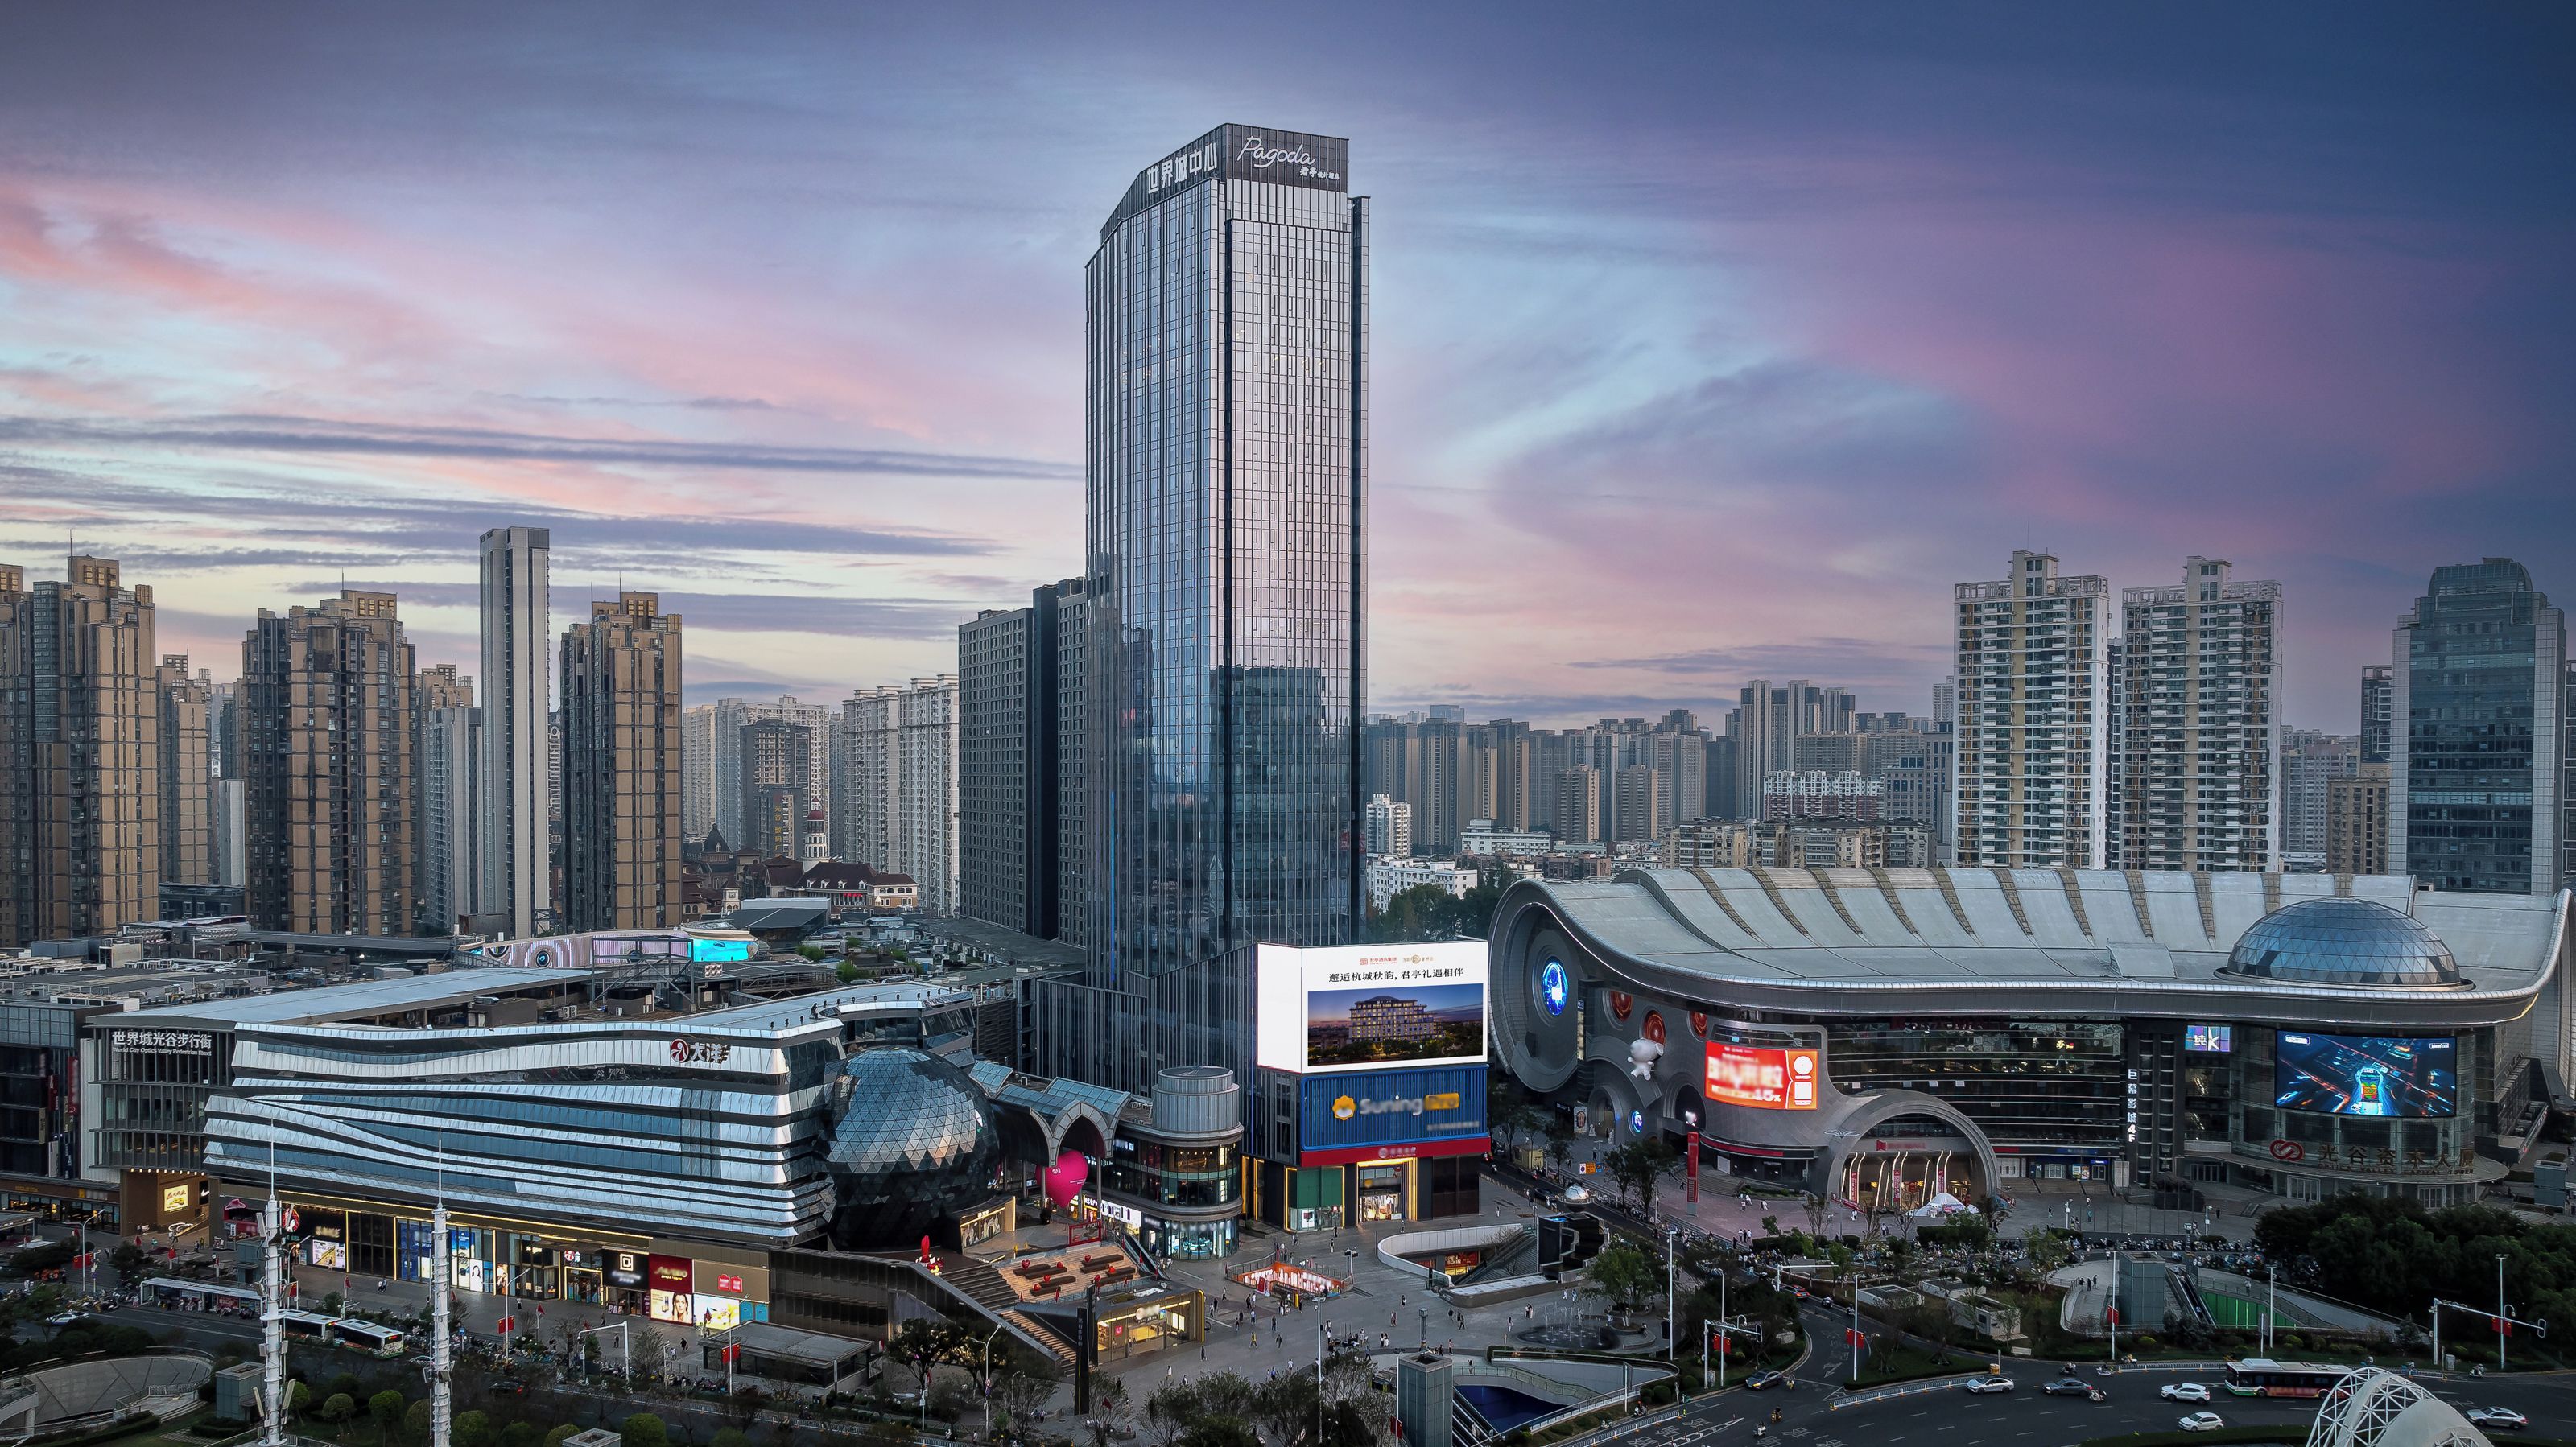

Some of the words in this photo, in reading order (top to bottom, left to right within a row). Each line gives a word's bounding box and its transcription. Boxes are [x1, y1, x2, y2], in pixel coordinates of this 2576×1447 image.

[1237, 136, 1315, 167] Pagoda
[1147, 142, 1217, 193] 世界城中心
[112, 1031, 212, 1049] 世界城光谷步行街
[690, 1041, 722, 1063] 大洋
[1360, 1095, 1422, 1115] Suning
[2318, 1144, 2474, 1169] 光谷资本大厦
